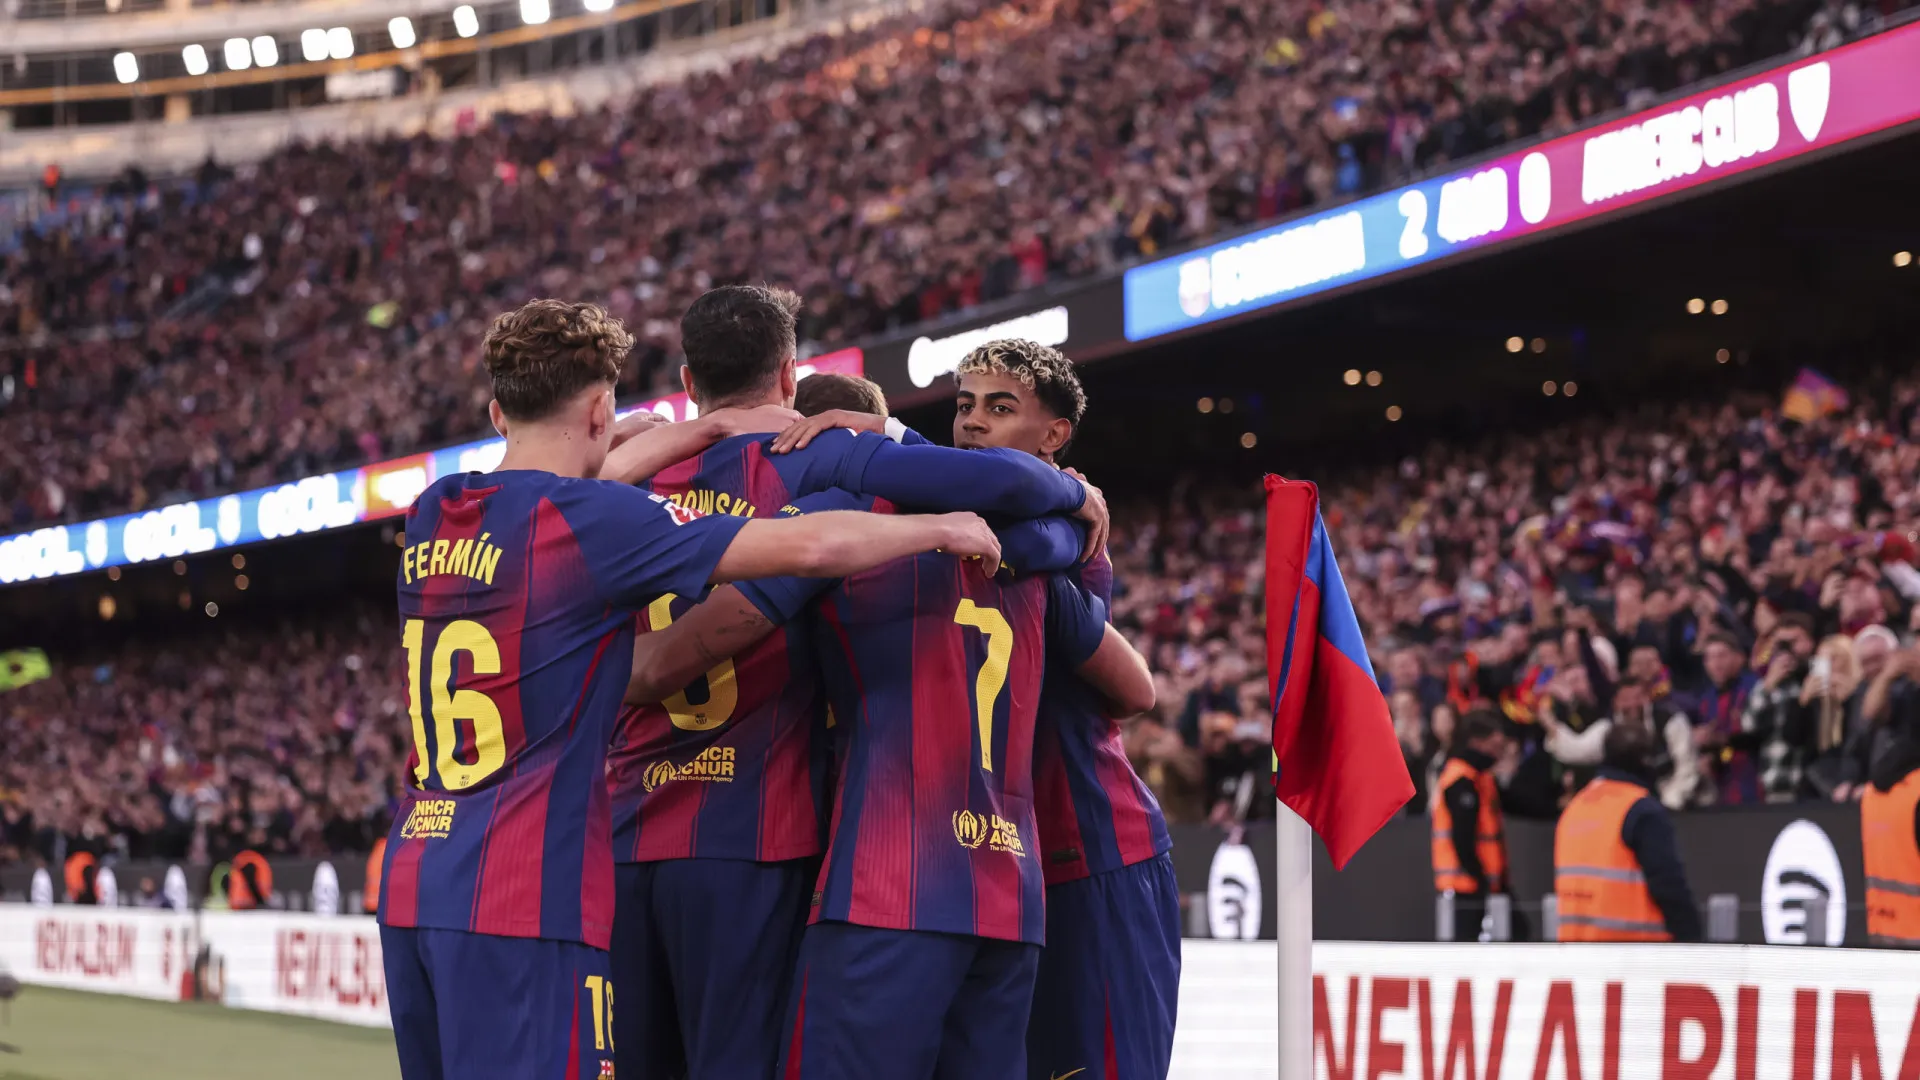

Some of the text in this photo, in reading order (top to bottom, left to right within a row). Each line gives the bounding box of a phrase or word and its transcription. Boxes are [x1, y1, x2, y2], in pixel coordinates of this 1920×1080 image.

[1398, 189, 1428, 259] 2
[403, 532, 503, 586] FERMÍN
[402, 619, 506, 791] 16
[954, 598, 1012, 773] 7
[415, 800, 456, 816] NHCR
[1313, 974, 1514, 1080] NEW
